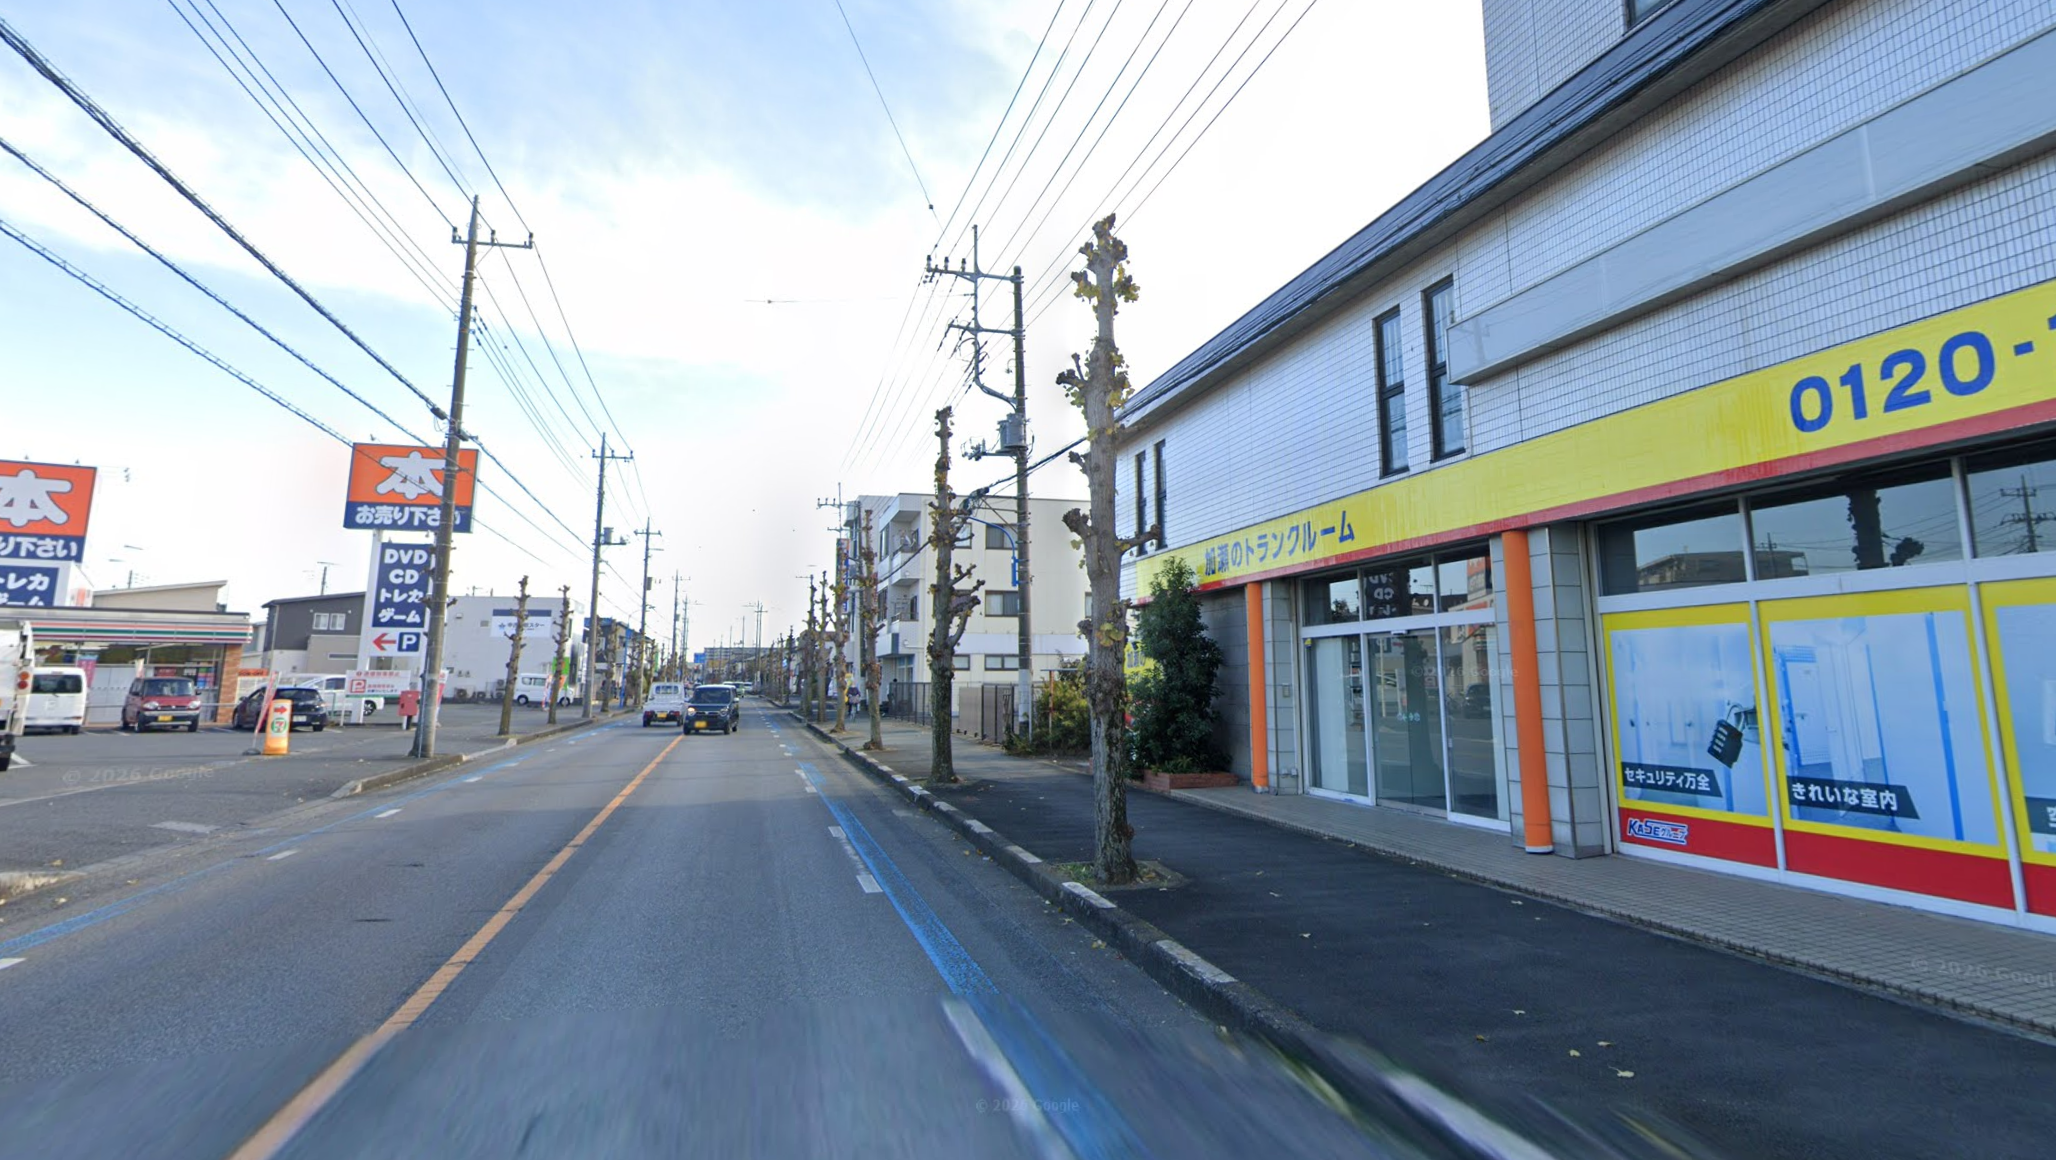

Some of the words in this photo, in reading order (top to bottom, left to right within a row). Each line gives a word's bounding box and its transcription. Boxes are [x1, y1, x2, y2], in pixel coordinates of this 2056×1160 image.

[374, 450, 445, 500] 本
[1205, 510, 1355, 576] 加瀬のトランクルーム
[384, 549, 428, 564] DVD
[389, 569, 419, 584] CD
[380, 588, 424, 602] トレカ
[378, 607, 421, 623] ゲーム
[402, 634, 417, 650] P
[1624, 766, 1711, 791] セキュリティ万全
[1792, 782, 1898, 811] きれいな室内
